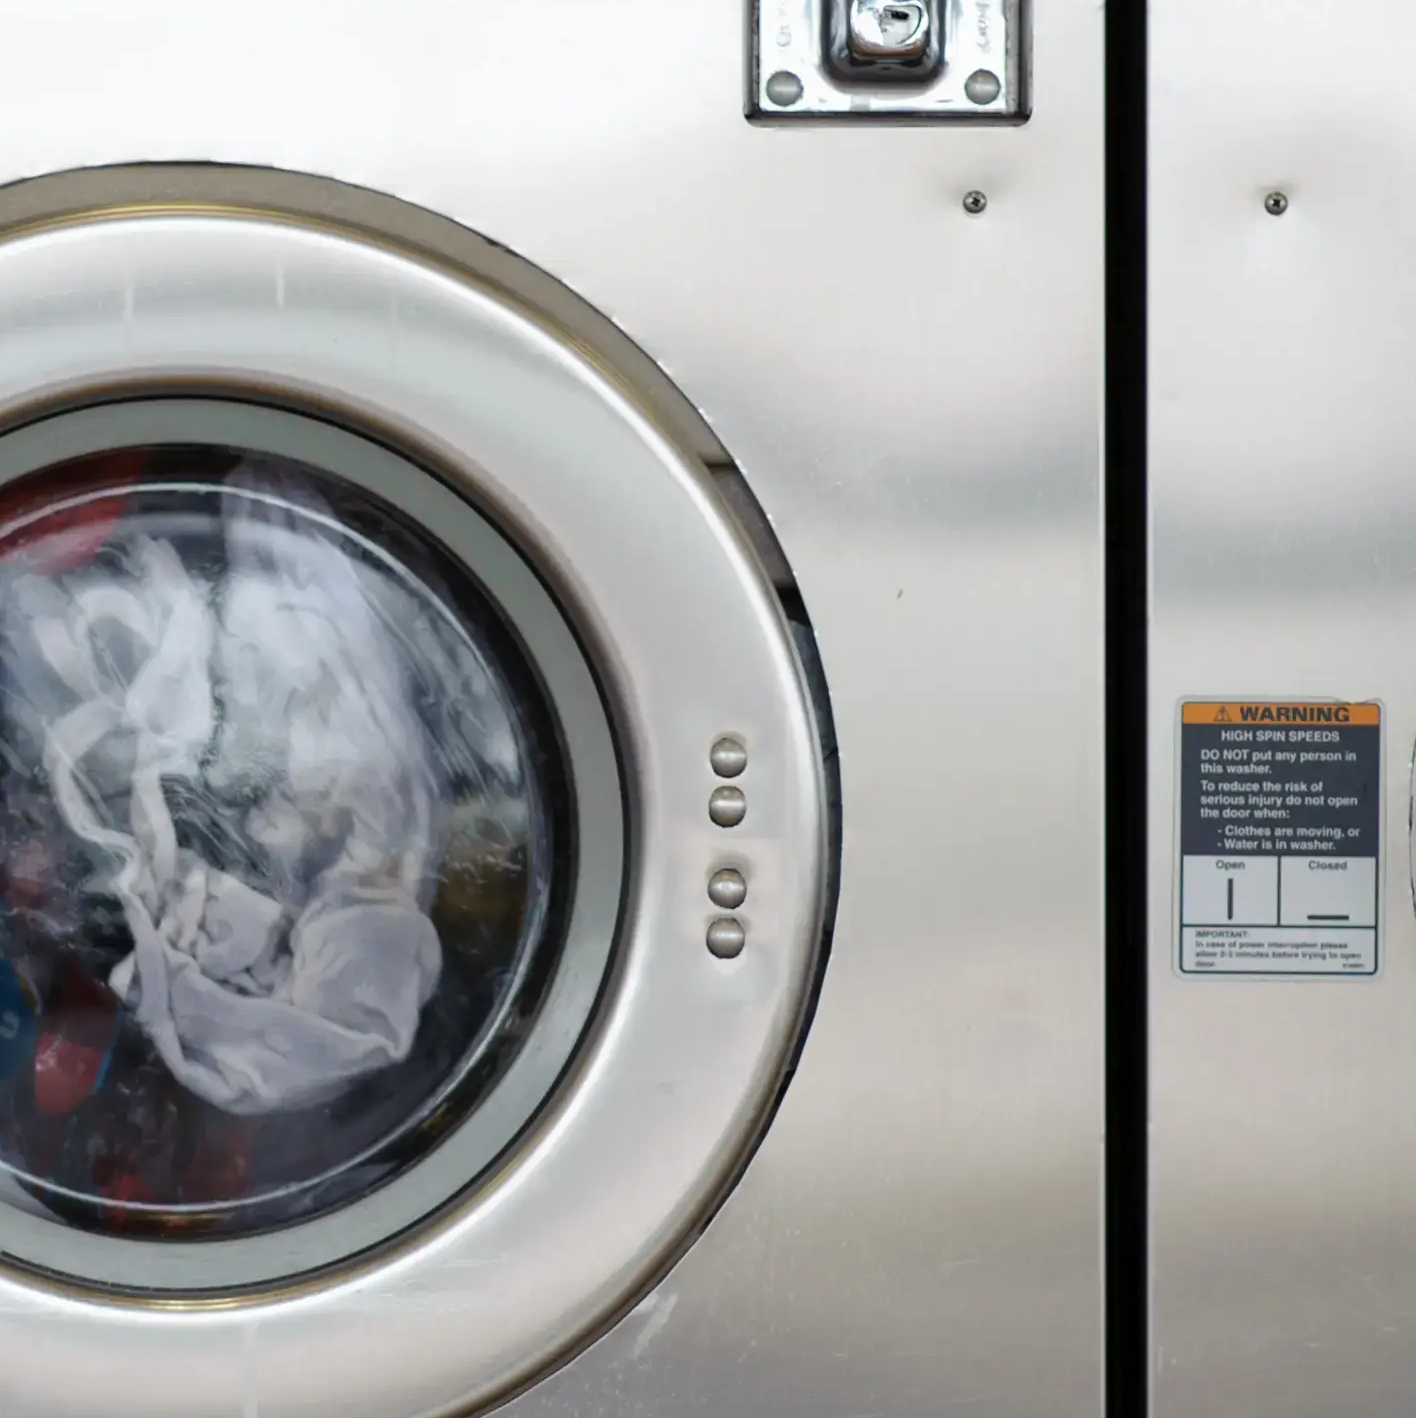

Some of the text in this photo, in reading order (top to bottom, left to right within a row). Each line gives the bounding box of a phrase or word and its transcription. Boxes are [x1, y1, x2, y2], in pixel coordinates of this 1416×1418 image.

[1240, 706, 1350, 722] WARNING
[1221, 731, 1339, 742] HIGH SPIN SPEEDS
[1201, 749, 1356, 763] DO NOT put any person in
[1201, 763, 1271, 774] this washer.
[1202, 780, 1323, 792] To reduce the risk of
[1201, 794, 1358, 807] serious injury do not open
[1201, 808, 1289, 819] the door when:
[1225, 825, 1359, 838] Clothes are moving, or
[1224, 839, 1336, 850] Water is in washer.
[1216, 860, 1245, 871] Open
[1308, 860, 1347, 870] Closed
